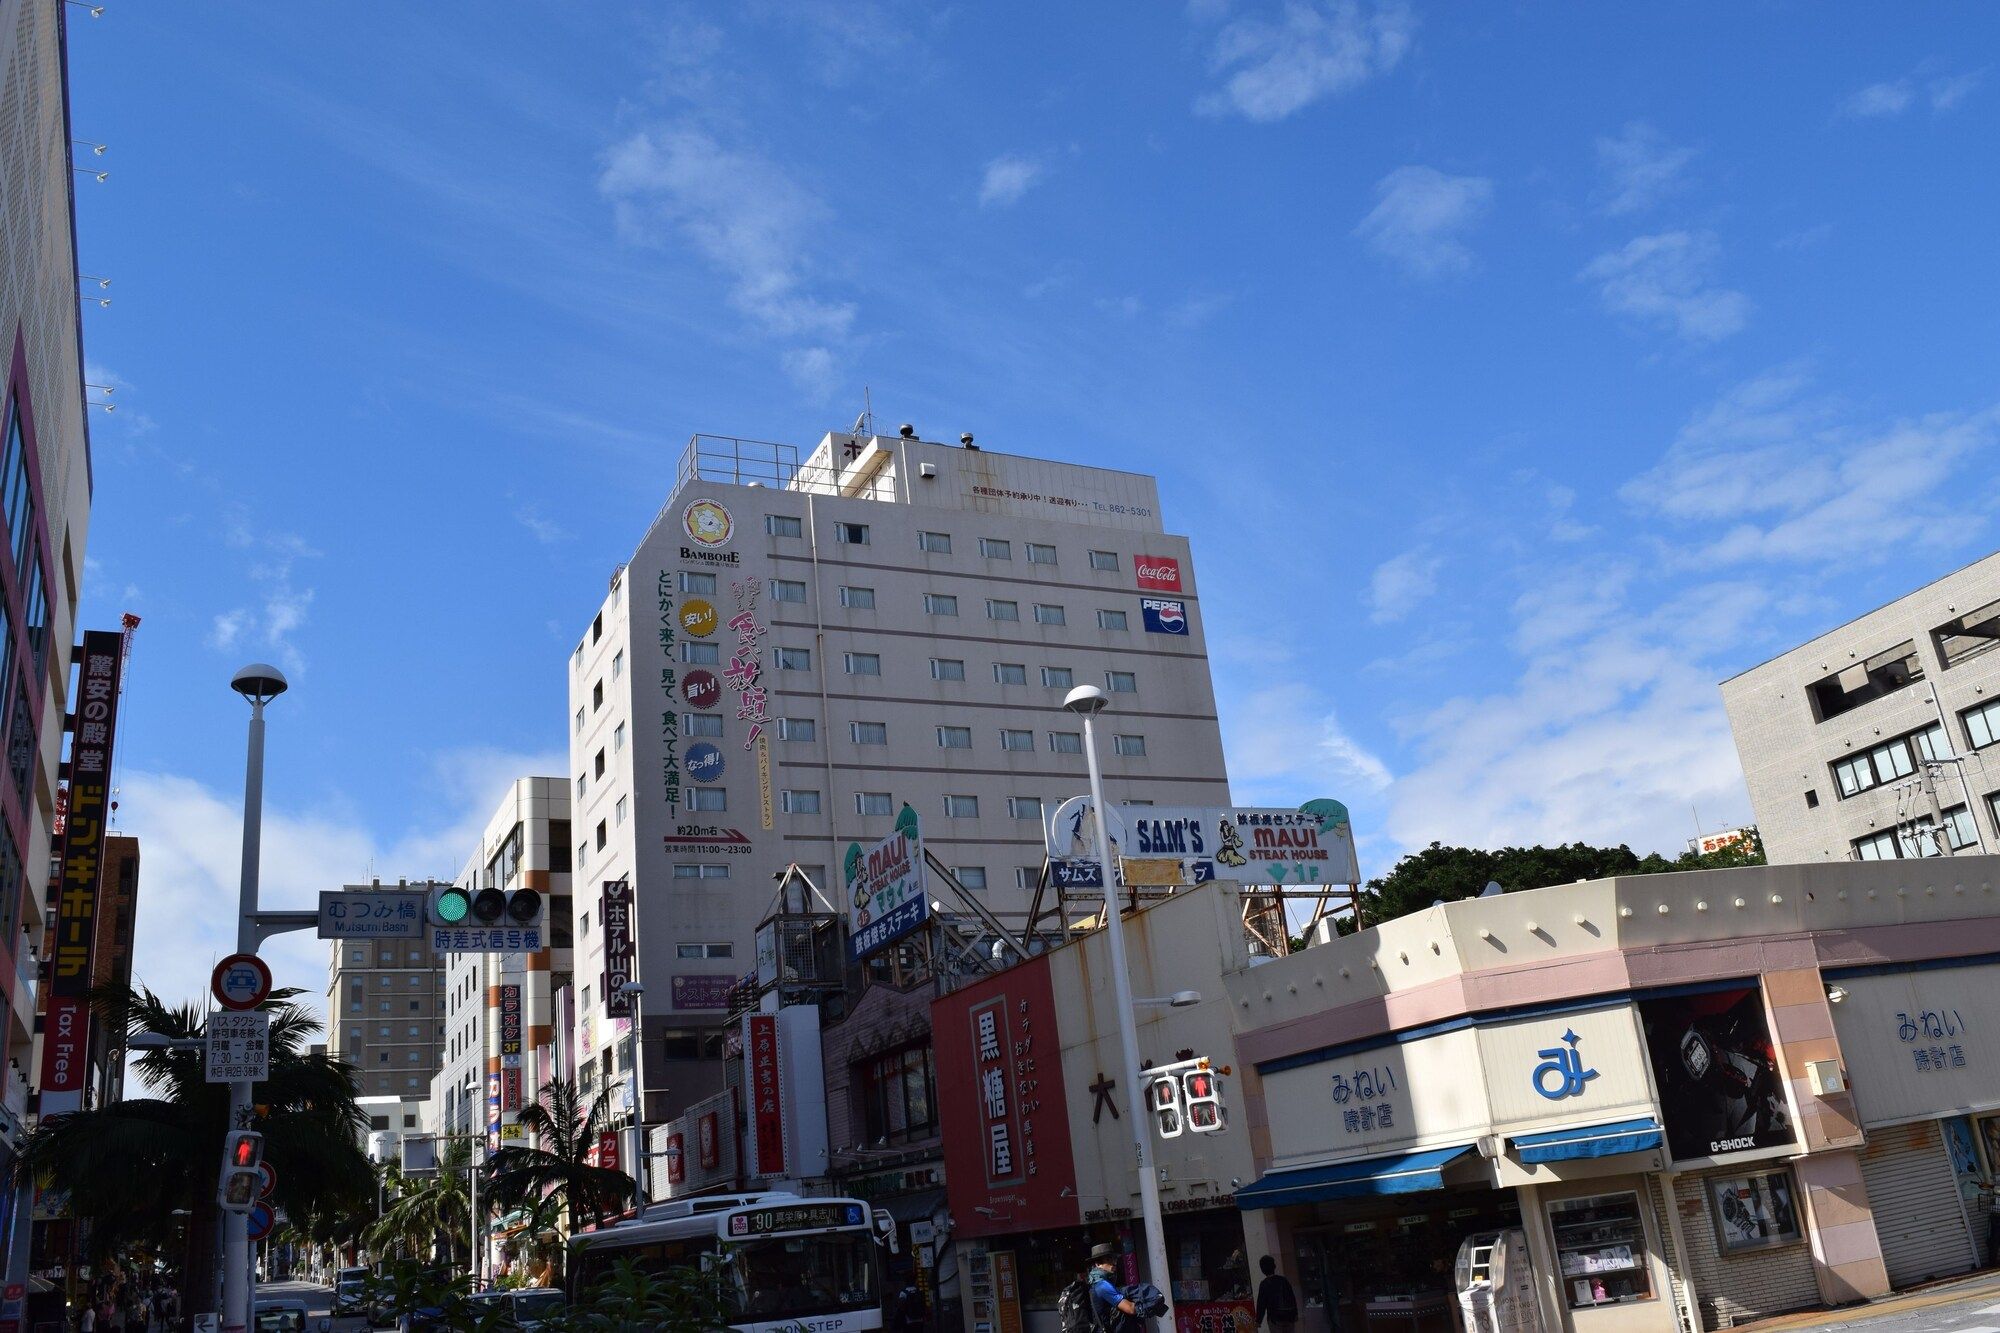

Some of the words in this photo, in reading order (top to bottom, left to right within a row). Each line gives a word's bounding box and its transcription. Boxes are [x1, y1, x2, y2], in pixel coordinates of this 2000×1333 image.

[680, 547, 740, 563] BAMBOHE
[1143, 600, 1183, 613] PEPSI
[1137, 818, 1204, 853] SAM'S
[1254, 828, 1318, 848] MAUI
[868, 835, 908, 880] MAUI
[1249, 849, 1289, 861] STEAK
[1291, 849, 1328, 860] HOUSE
[328, 900, 417, 920] むつみ橋
[855, 902, 919, 954] 鉄板焼きステーキ
[435, 930, 539, 950] 時差式信号機
[56, 1005, 77, 1038] Tax
[504, 986, 518, 1039] カラオケ
[211, 1028, 264, 1039] 許可車を除く
[1897, 1010, 1966, 1042] みねい
[504, 1043, 519, 1054] 3F
[1912, 1045, 1966, 1071] 時計店
[54, 1043, 75, 1085] Free
[978, 1010, 1012, 1176] 黒糖屋
[1332, 1066, 1397, 1103] みねい
[1343, 1102, 1394, 1133] 時計店
[1710, 1136, 1756, 1153] G-SHOCK
[756, 1212, 773, 1230] 90
[808, 1319, 843, 1333] STEP
